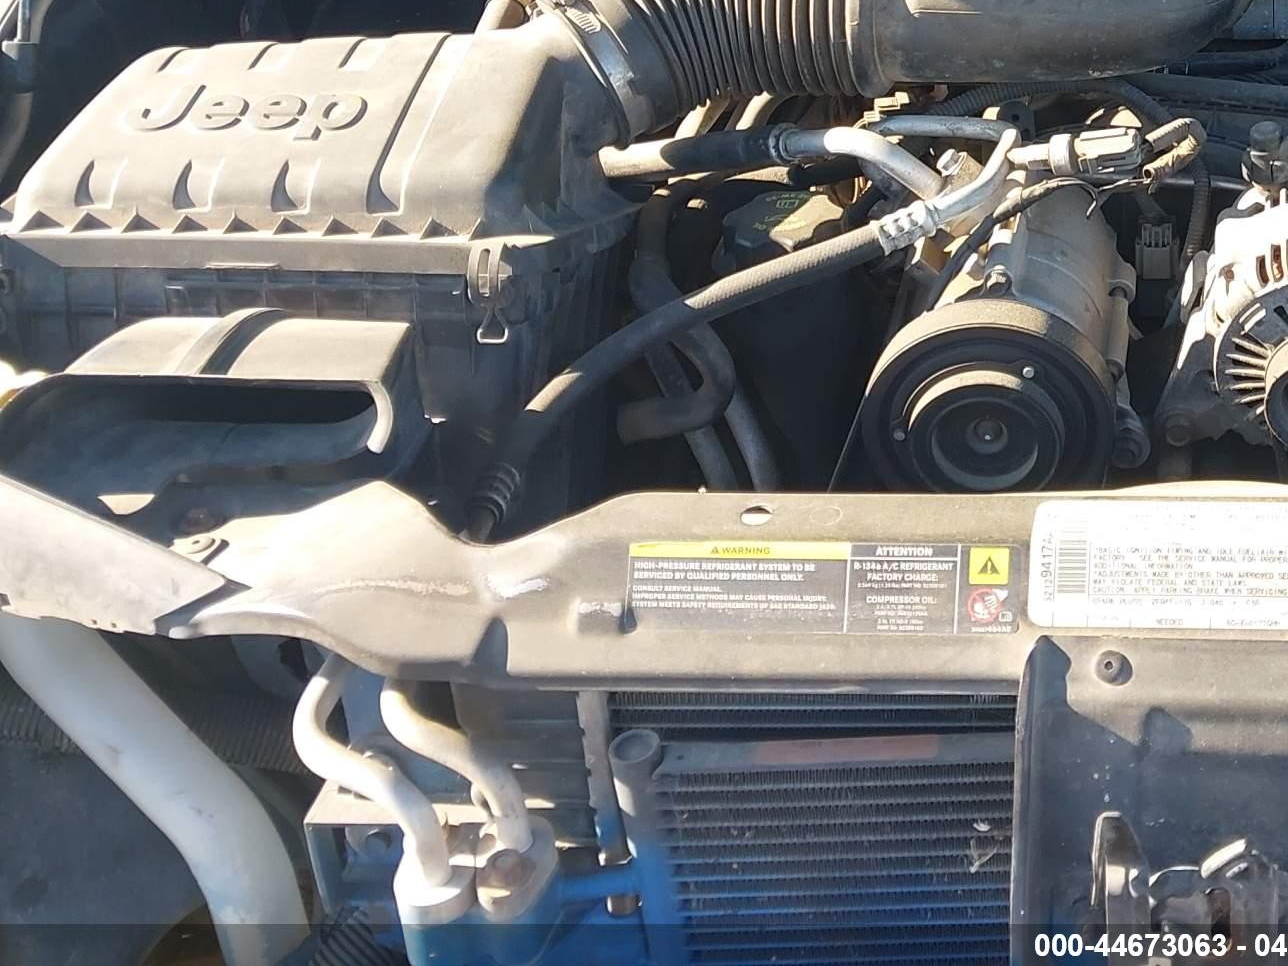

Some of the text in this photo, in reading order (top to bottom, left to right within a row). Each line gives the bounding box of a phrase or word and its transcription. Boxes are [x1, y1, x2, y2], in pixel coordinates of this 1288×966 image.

[126, 84, 368, 141] Jeep
[722, 546, 771, 555] WARNING
[875, 545, 934, 556] ATTENTION
[633, 561, 816, 572] HIGH-PRESSURE REFRIGERANT SYSTEM TO BE
[882, 561, 899, 571] A/C
[900, 562, 954, 571] REFRIGERANT
[633, 571, 673, 579] SERVICED
[674, 571, 685, 580] BY
[687, 572, 730, 580] QUALIFIED
[731, 572, 780, 581] PERSONNEL
[867, 572, 939, 581] FACTORY CHARGE:
[866, 595, 920, 603] COMPRESSOR
